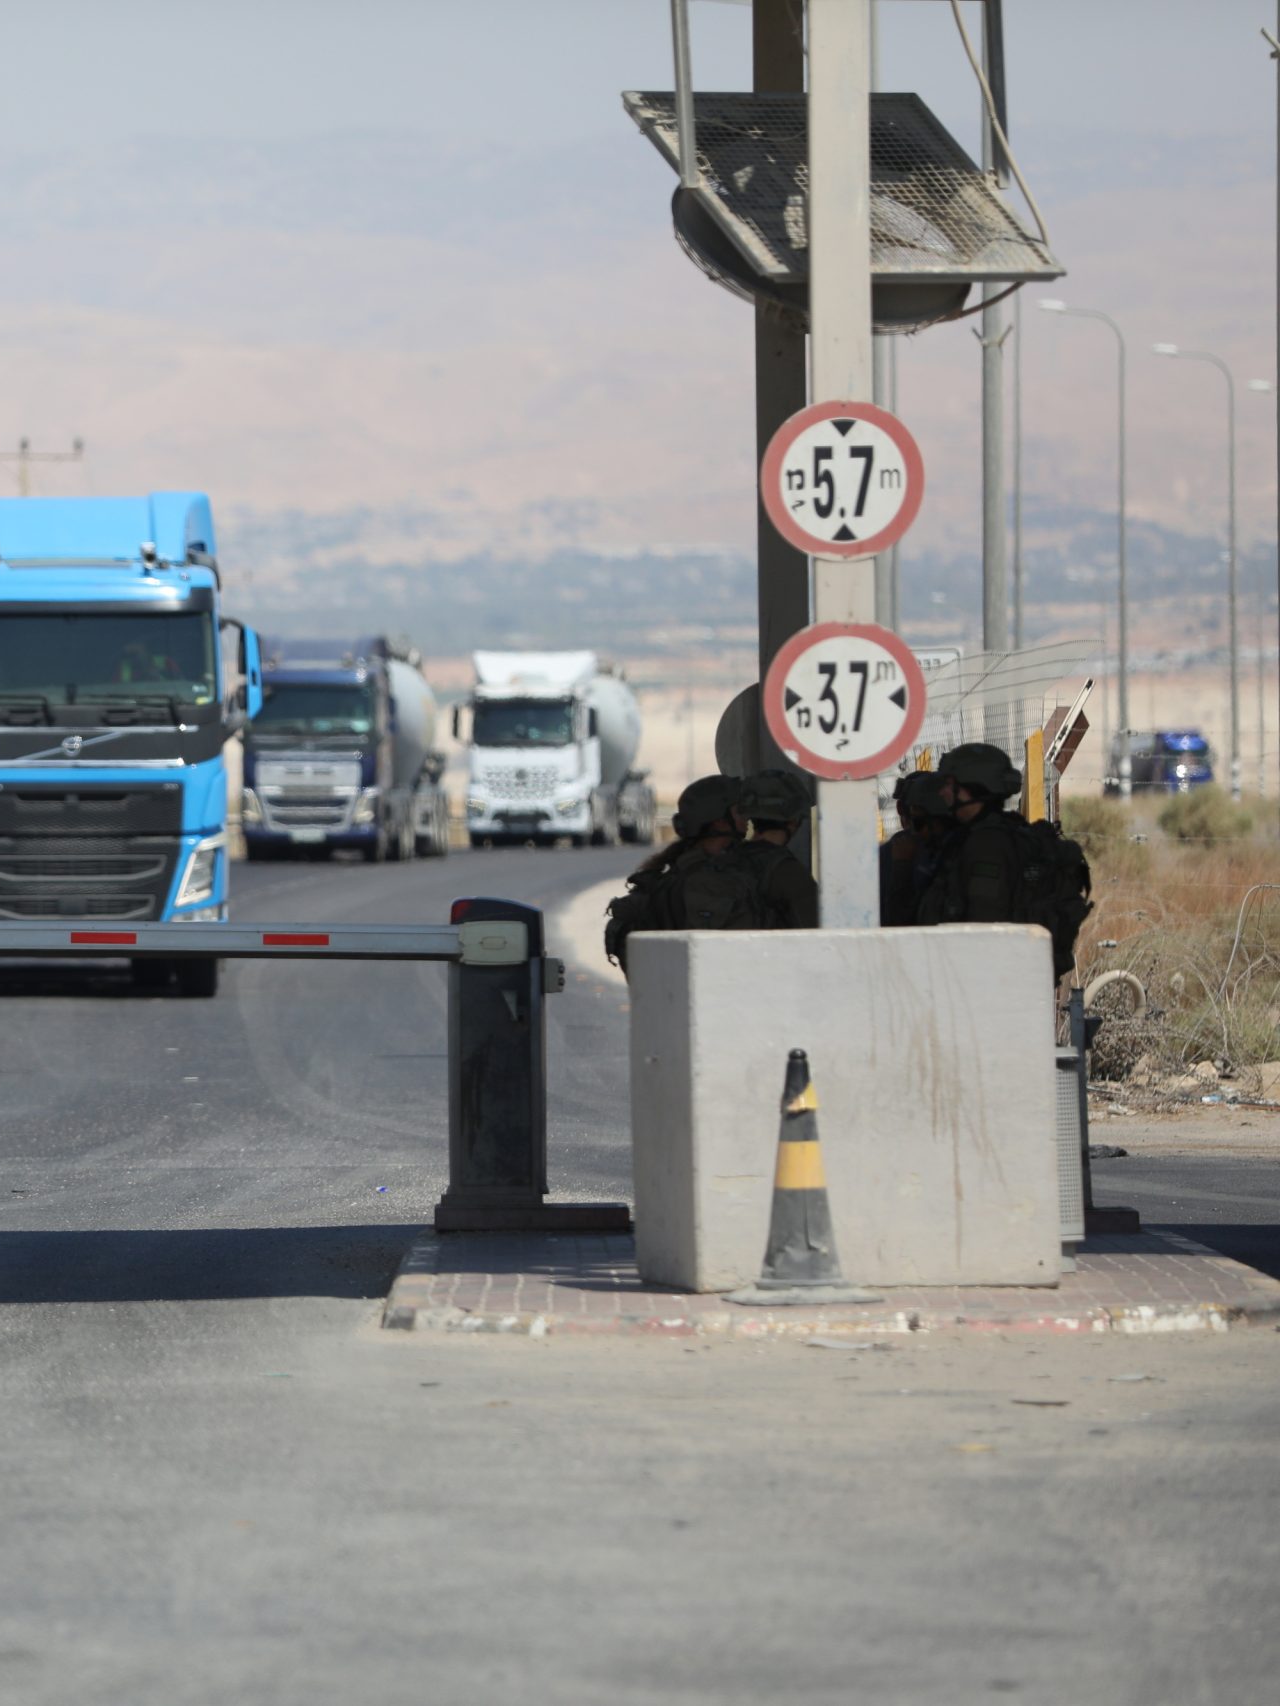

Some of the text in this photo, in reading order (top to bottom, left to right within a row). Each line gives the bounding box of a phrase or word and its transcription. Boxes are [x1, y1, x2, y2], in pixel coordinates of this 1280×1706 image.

[813, 446, 901, 518] 5.7 m
[818, 661, 868, 734] 3.7
